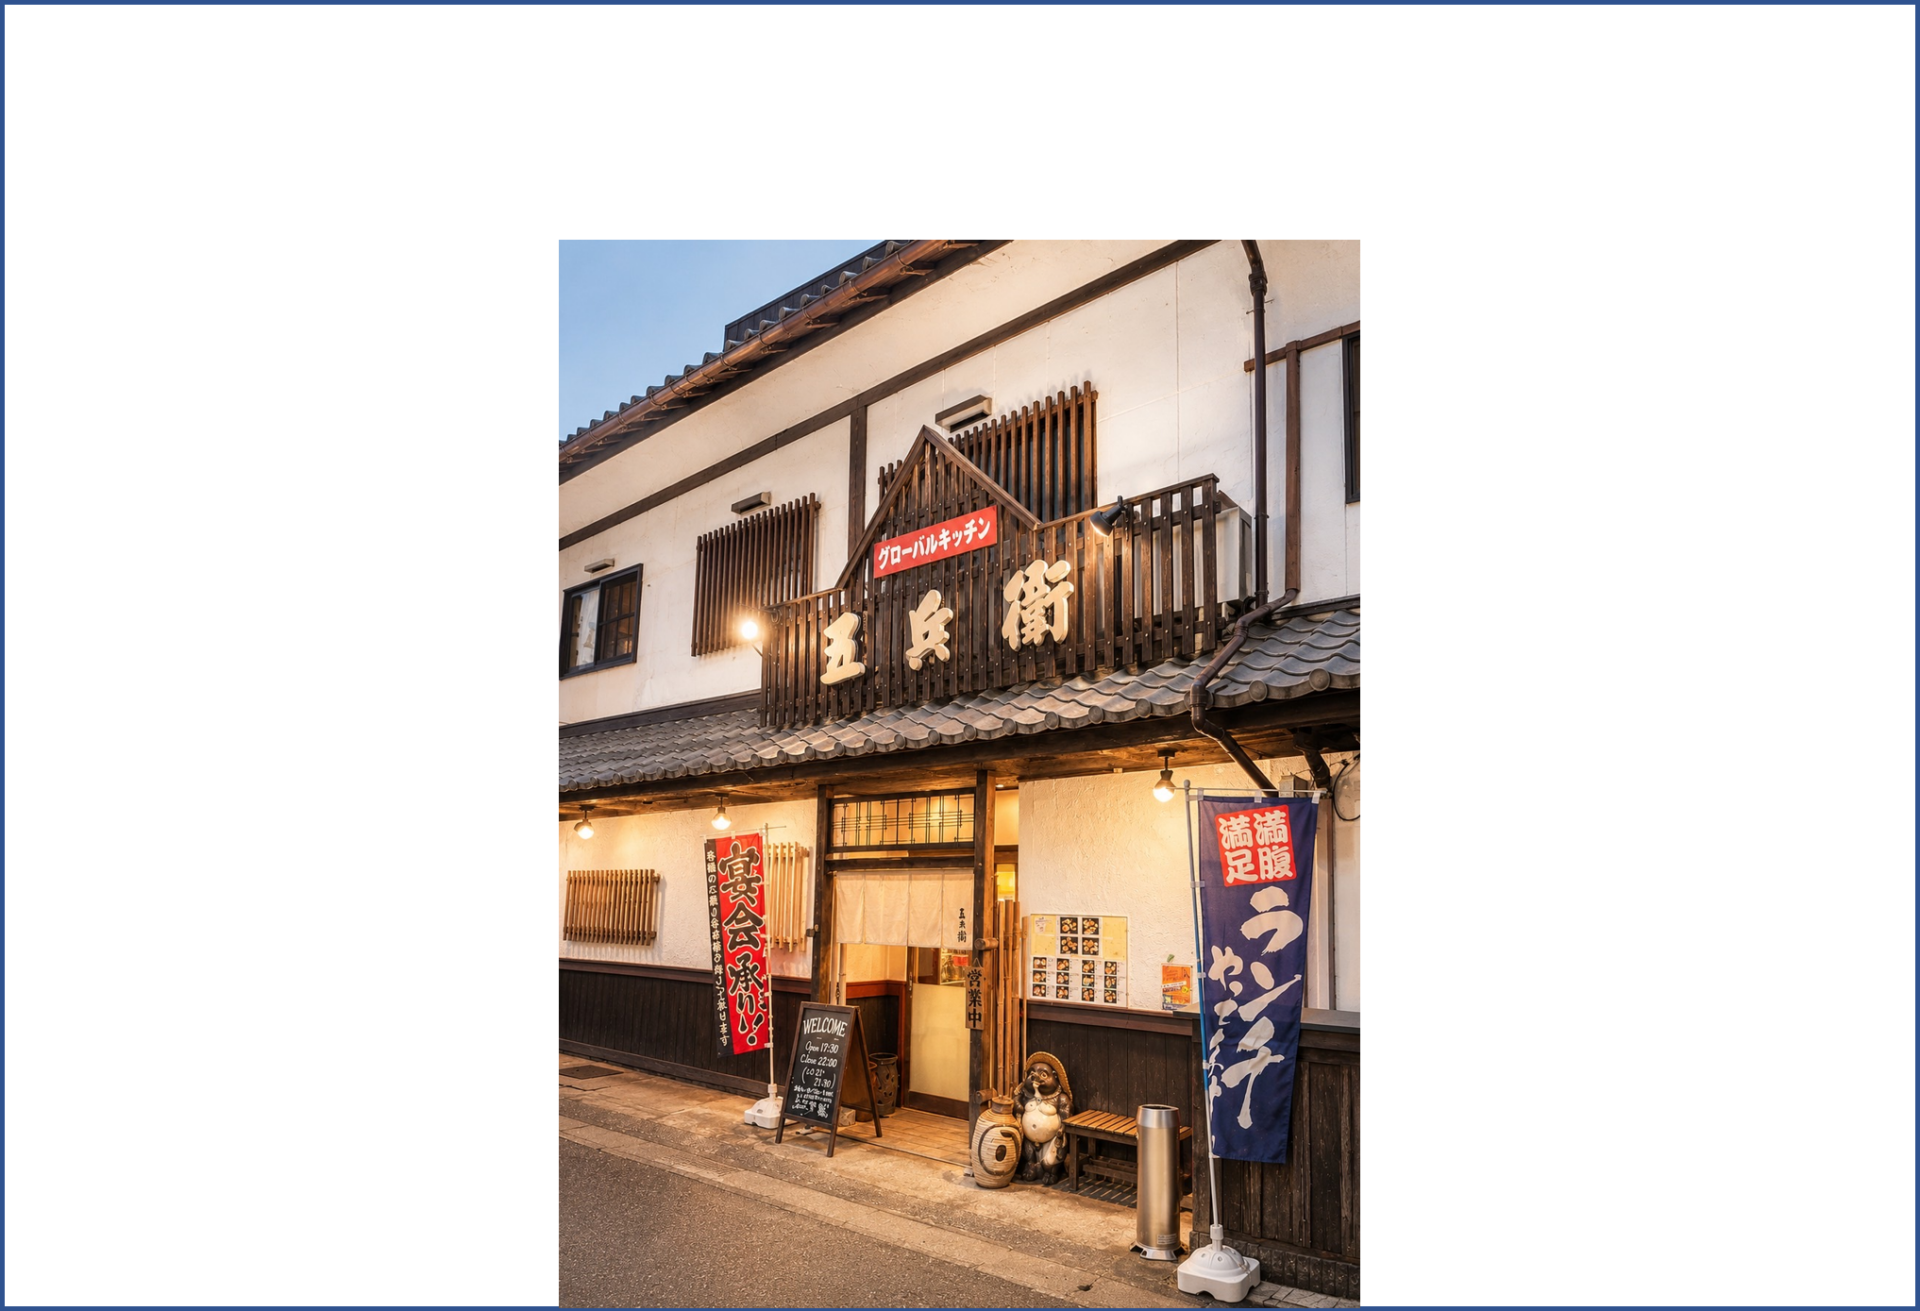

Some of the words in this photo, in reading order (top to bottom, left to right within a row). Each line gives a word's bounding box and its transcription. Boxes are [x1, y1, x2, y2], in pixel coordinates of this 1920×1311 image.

[878, 516, 991, 570] グローバルキッチン
[820, 559, 1074, 686] 五兵衛
[1219, 814, 1258, 884] 満足
[1253, 810, 1294, 881] 満腹
[803, 1017, 848, 1037] WELCOME
[967, 968, 982, 1028] 営業中
[1221, 886, 1303, 1129] ランチ
[800, 1054, 816, 1064] Close
[818, 1057, 837, 1067] 22:00
[805, 1041, 819, 1053] Open
[820, 1043, 839, 1054] 17:30
